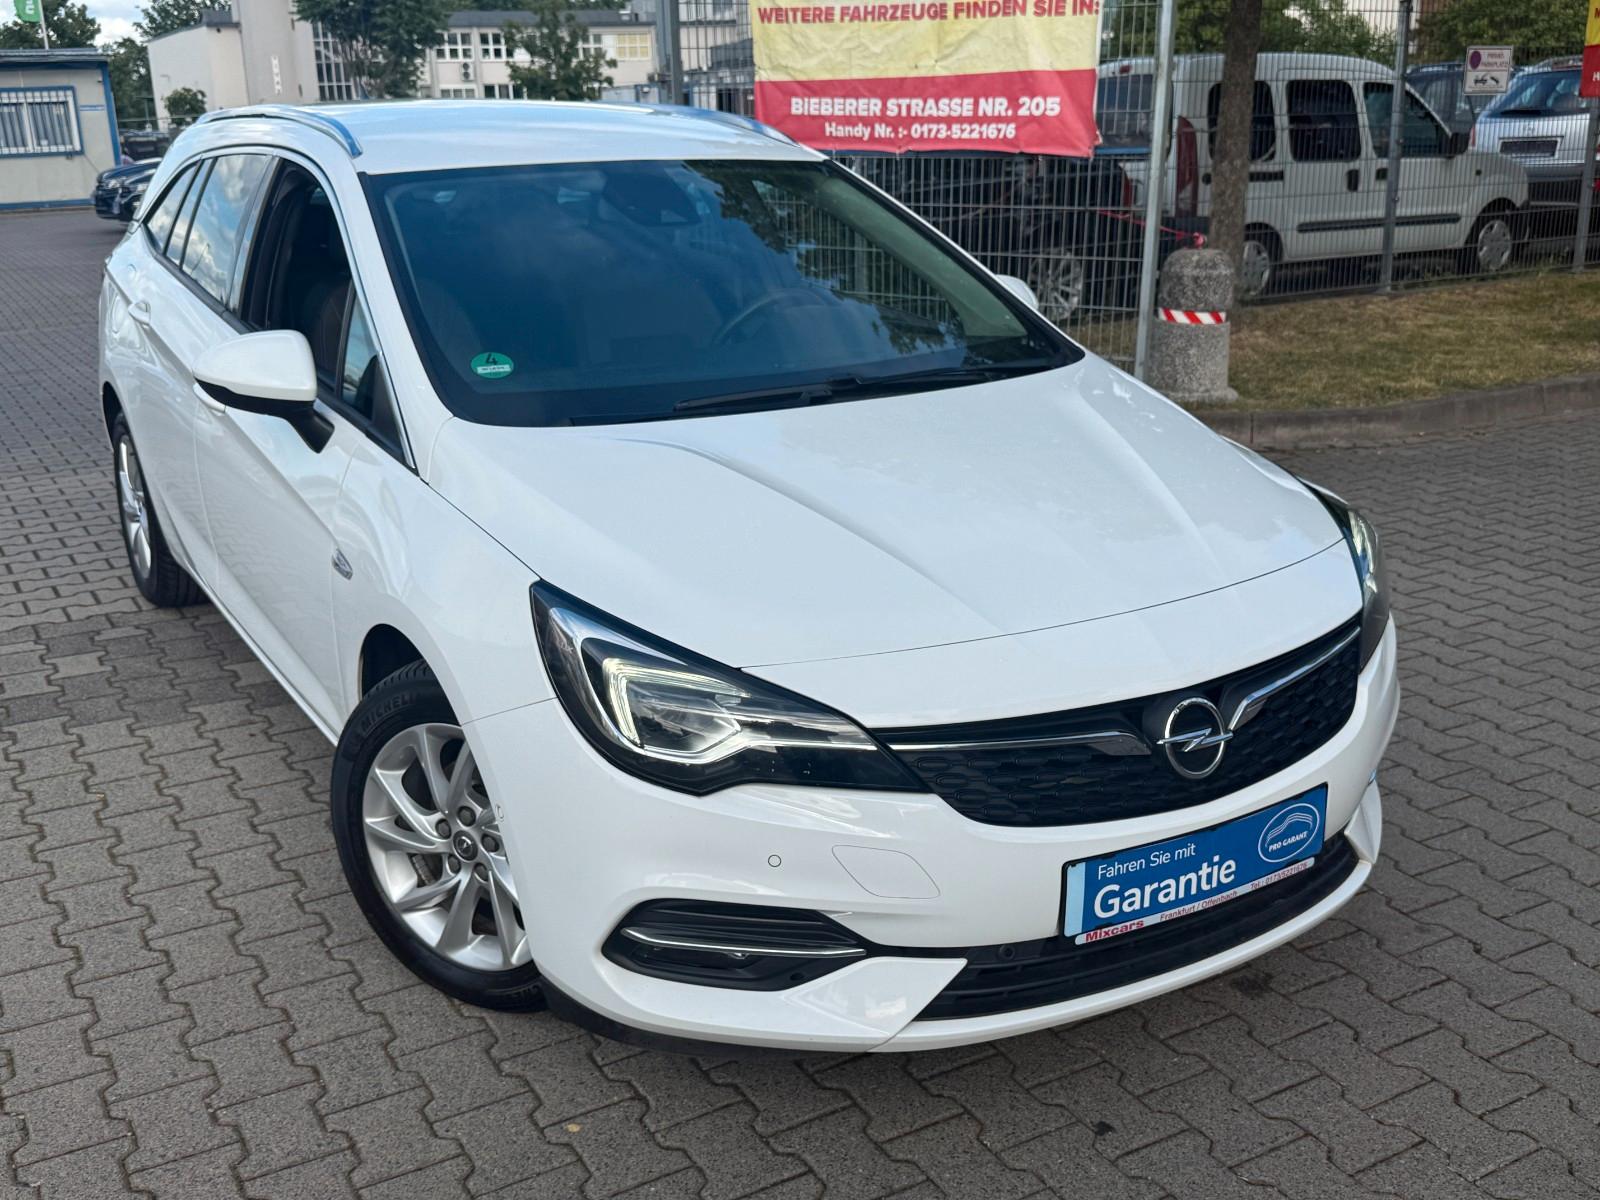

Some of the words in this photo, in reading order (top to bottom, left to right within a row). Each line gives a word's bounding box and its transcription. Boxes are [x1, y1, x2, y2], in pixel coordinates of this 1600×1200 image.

[758, 6, 835, 24] WEITERE
[840, 3, 948, 23] FAHRZEUGE
[953, 0, 1027, 19] FINDEN
[1033, 0, 1066, 16] SIE
[1072, 0, 1100, 16] IN:
[790, 96, 882, 116] BIEBERER
[886, 96, 974, 117] STRASSE
[978, 96, 1013, 117] NR.
[1017, 96, 1061, 116] 205
[824, 122, 871, 140] Handy
[874, 123, 895, 138] Nr.
[910, 122, 1017, 139] 0173-5221676
[486, 353, 497, 366] 4
[361, 692, 416, 732] MICHELI
[1269, 841, 1282, 853] PRO
[1282, 831, 1309, 847] GARANT
[1098, 858, 1146, 880] Fahren
[1149, 852, 1171, 867] Sie
[1174, 842, 1196, 860] mit
[1094, 855, 1237, 919] Garantie
[1085, 920, 1145, 943] Mixcars
[1160, 905, 1196, 921] Frankfurt
[1201, 890, 1238, 910] Offenbach
